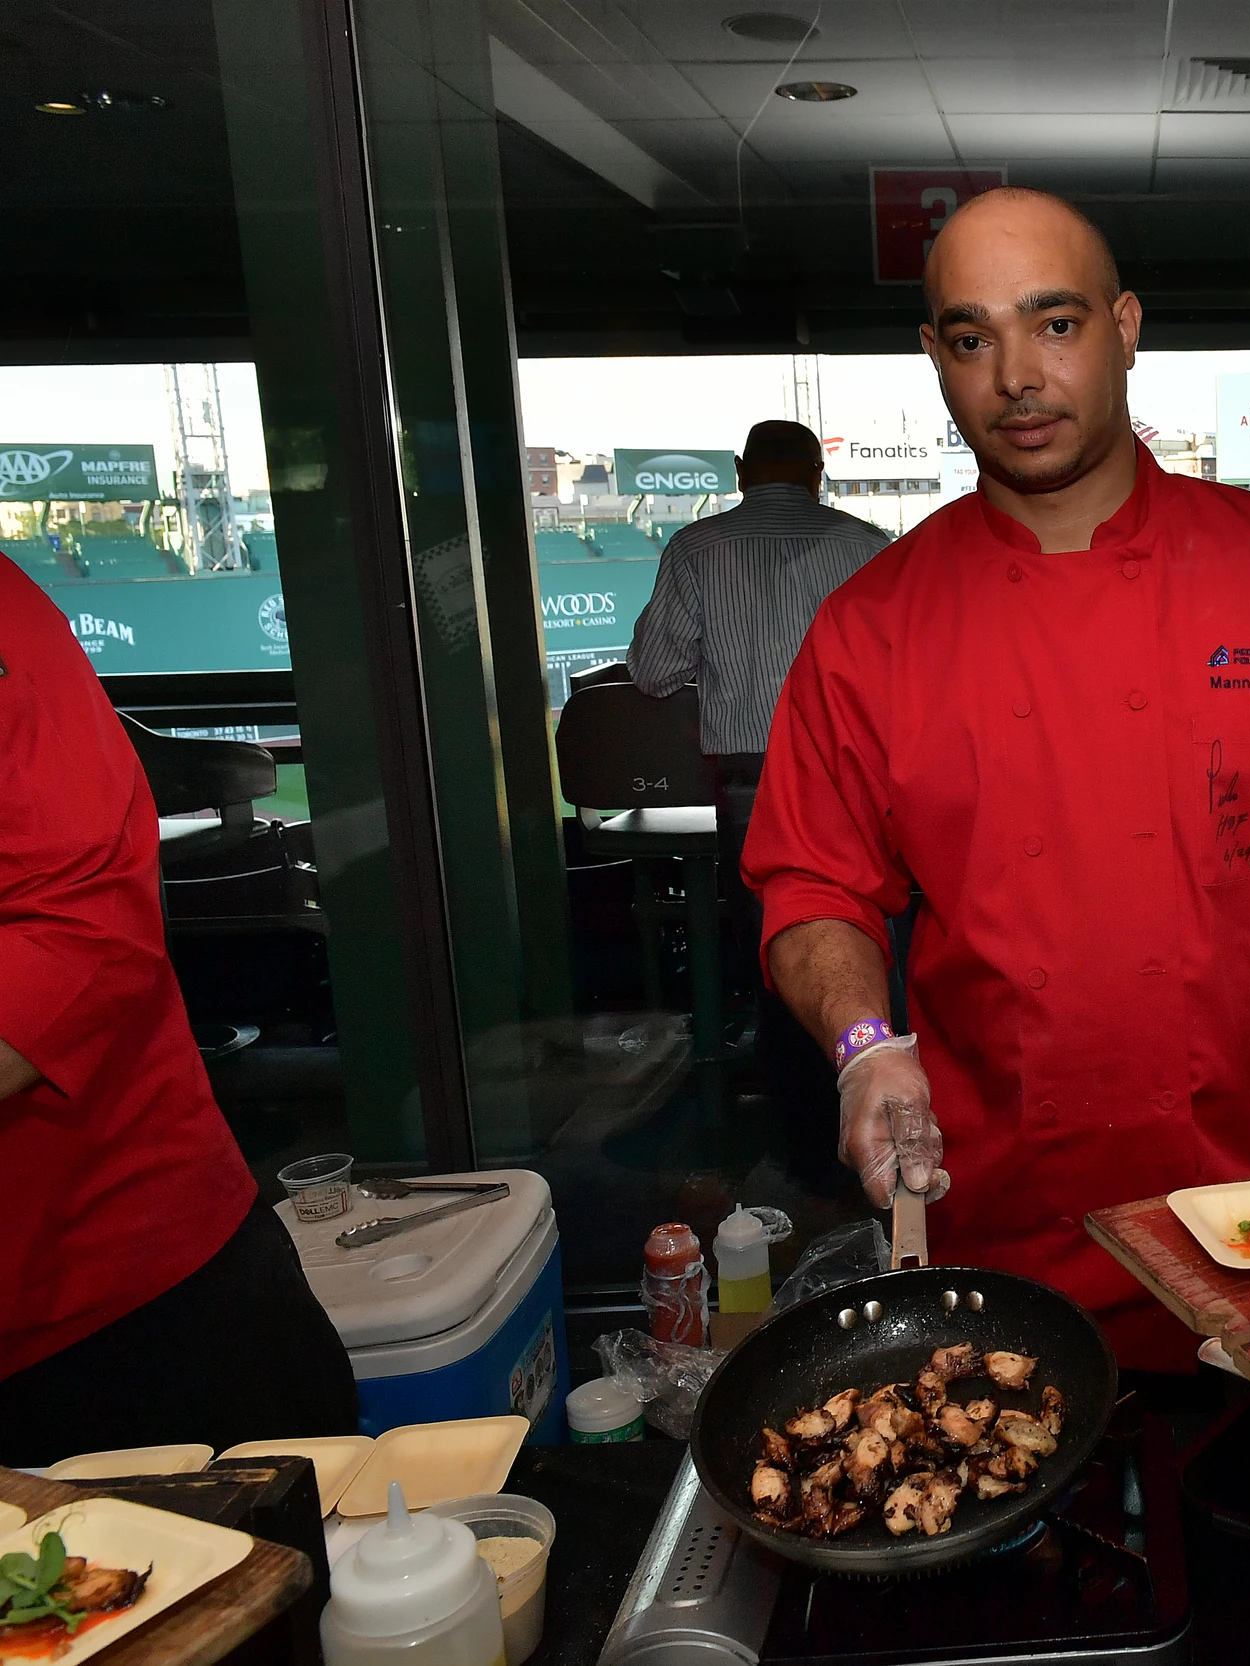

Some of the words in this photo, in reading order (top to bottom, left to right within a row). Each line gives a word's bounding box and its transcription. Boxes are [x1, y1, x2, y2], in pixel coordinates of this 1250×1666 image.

[1240, 415, 1248, 426] A
[850, 442, 928, 459] Fanatics
[81, 460, 150, 472] MAPFRE
[87, 474, 148, 485] INSURANCE
[541, 592, 615, 616] WOODS
[79, 613, 135, 646] BEAM
[543, 618, 575, 629] RESORT
[582, 616, 616, 627] CASINO
[632, 776, 670, 792] 3-4
